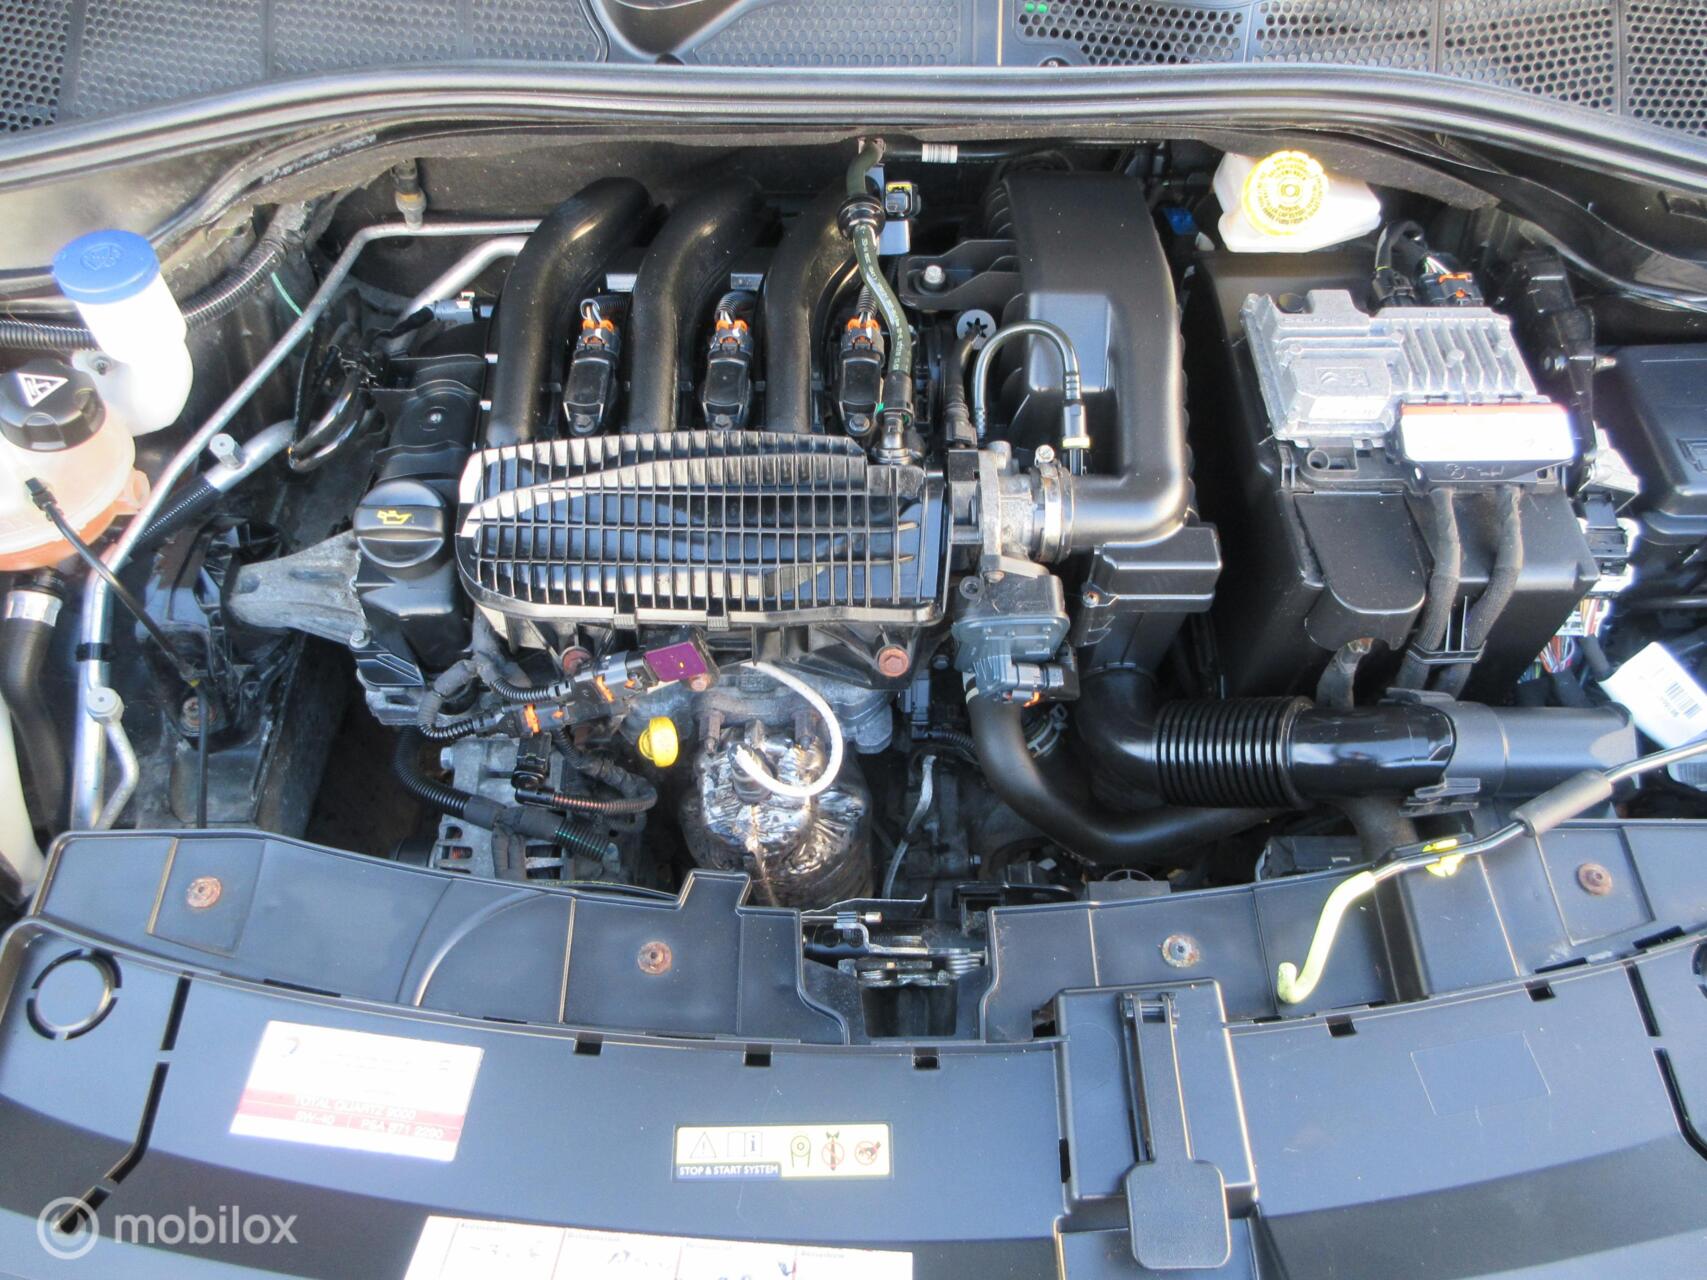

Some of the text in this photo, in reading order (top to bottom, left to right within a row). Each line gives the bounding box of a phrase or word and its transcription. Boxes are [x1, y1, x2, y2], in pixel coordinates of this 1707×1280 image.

[295, 1095, 330, 1109] TOTAL
[334, 1099, 385, 1115] QUARTZ
[680, 1166, 704, 1176] STOP
[713, 1165, 742, 1175] START
[743, 1165, 778, 1175] SYSTEM
